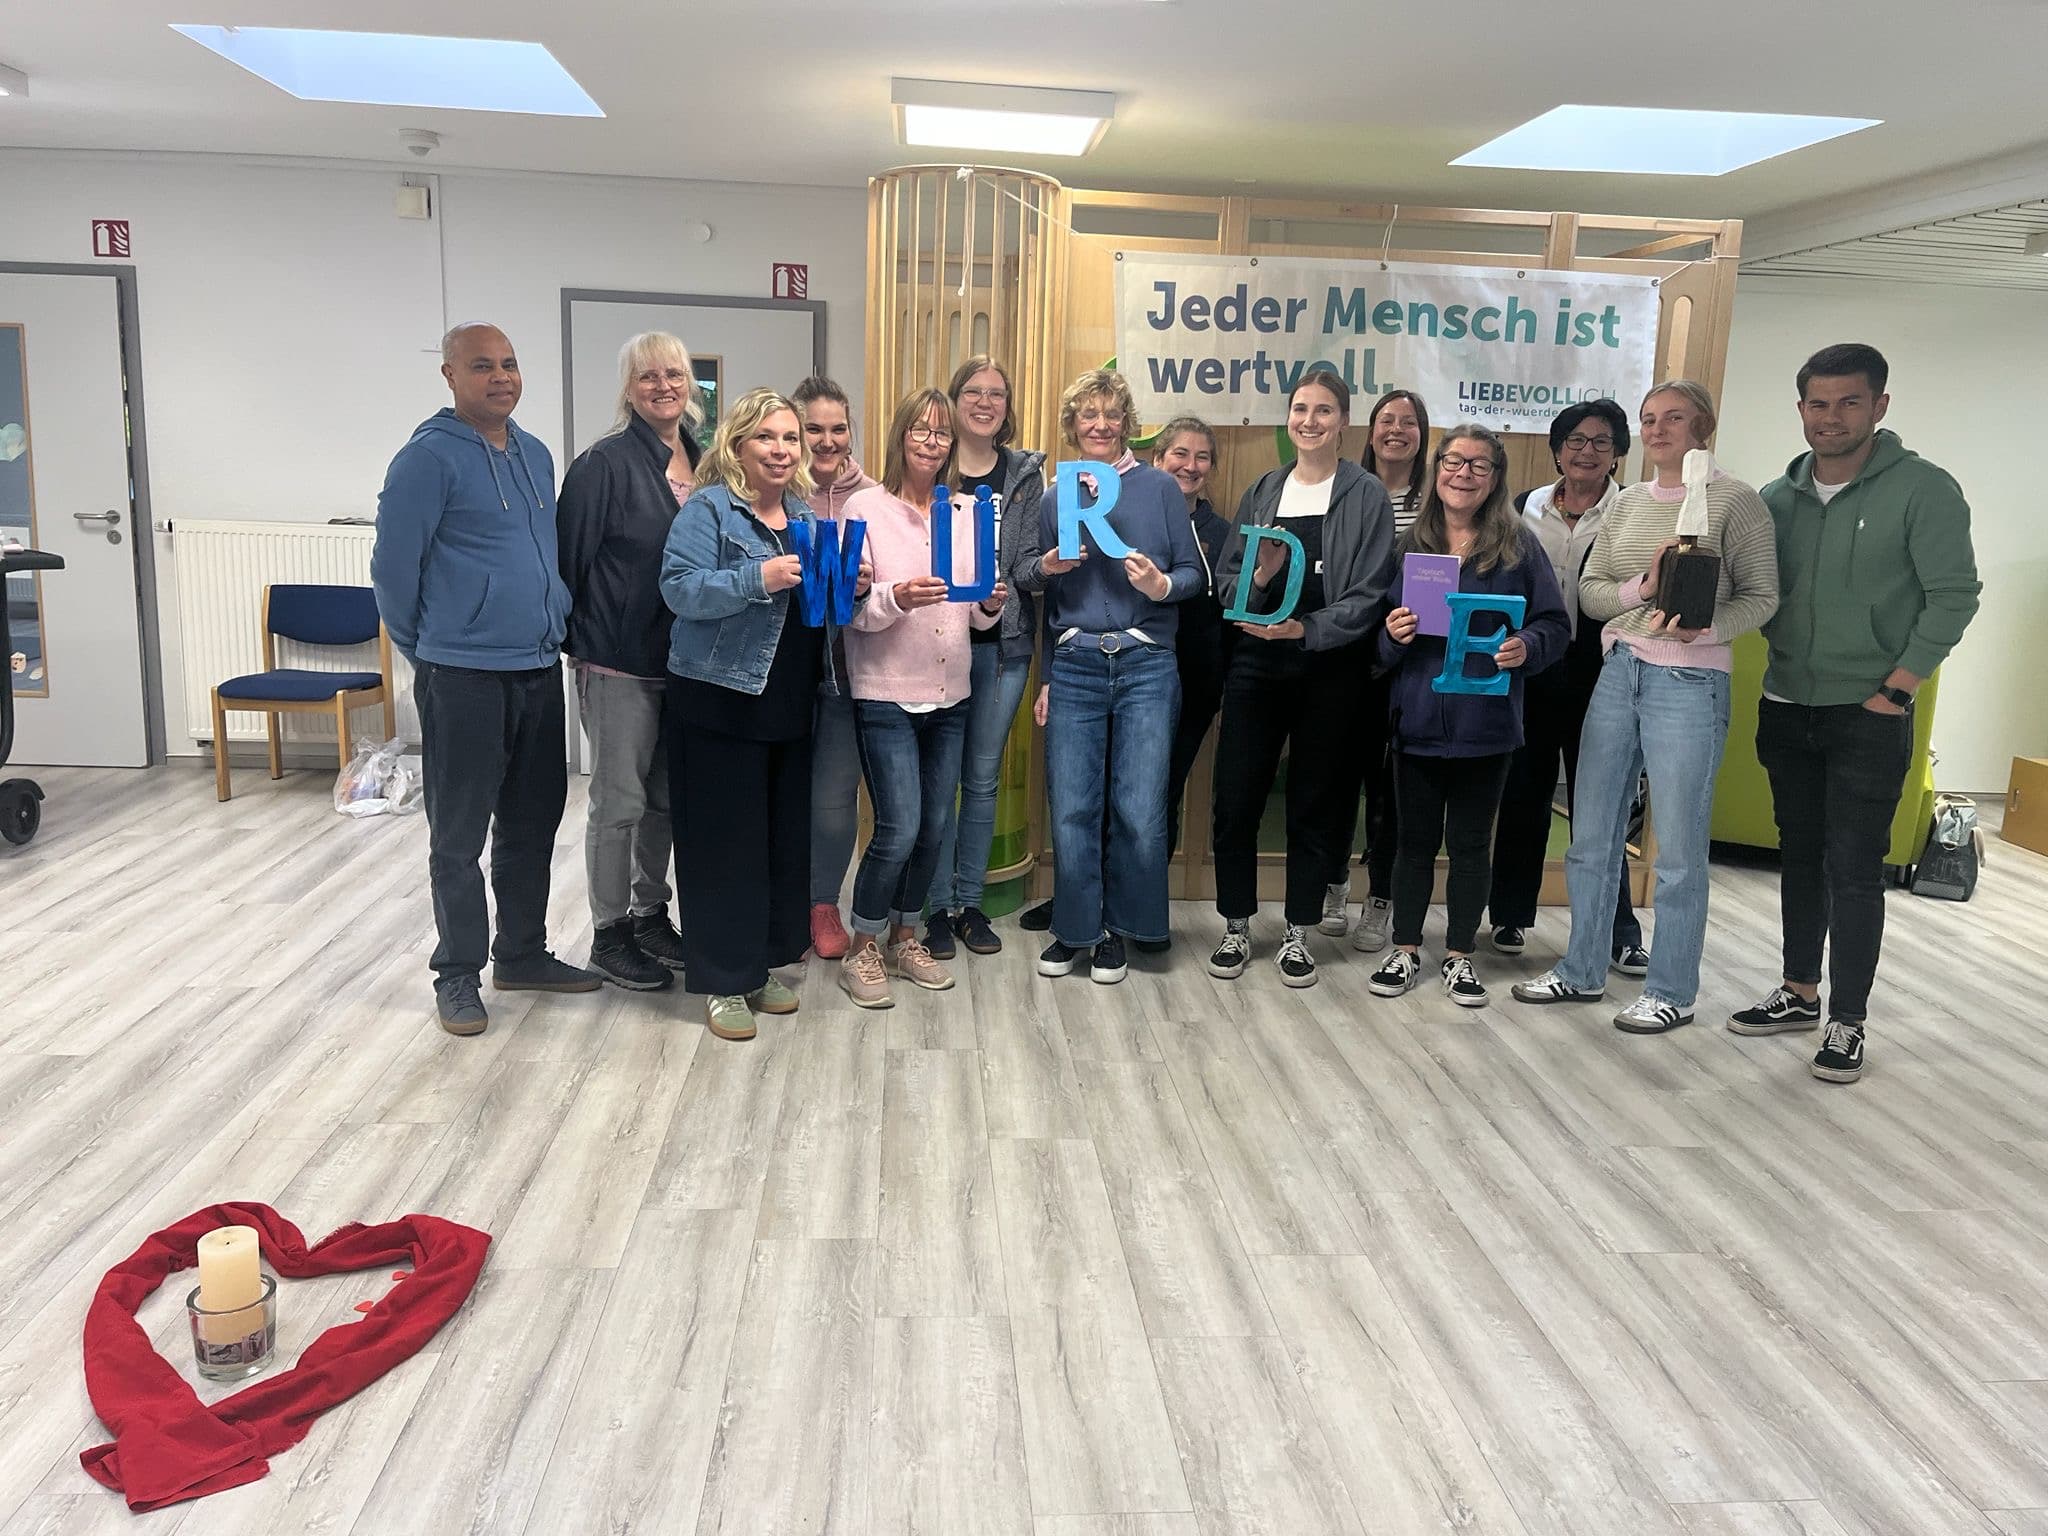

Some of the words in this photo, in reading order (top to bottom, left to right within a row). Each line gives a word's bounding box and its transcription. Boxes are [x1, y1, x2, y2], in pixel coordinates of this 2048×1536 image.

[1147, 281, 1308, 333] Jeder
[1322, 286, 1538, 344] Mensch
[1554, 298, 1621, 348] ist
